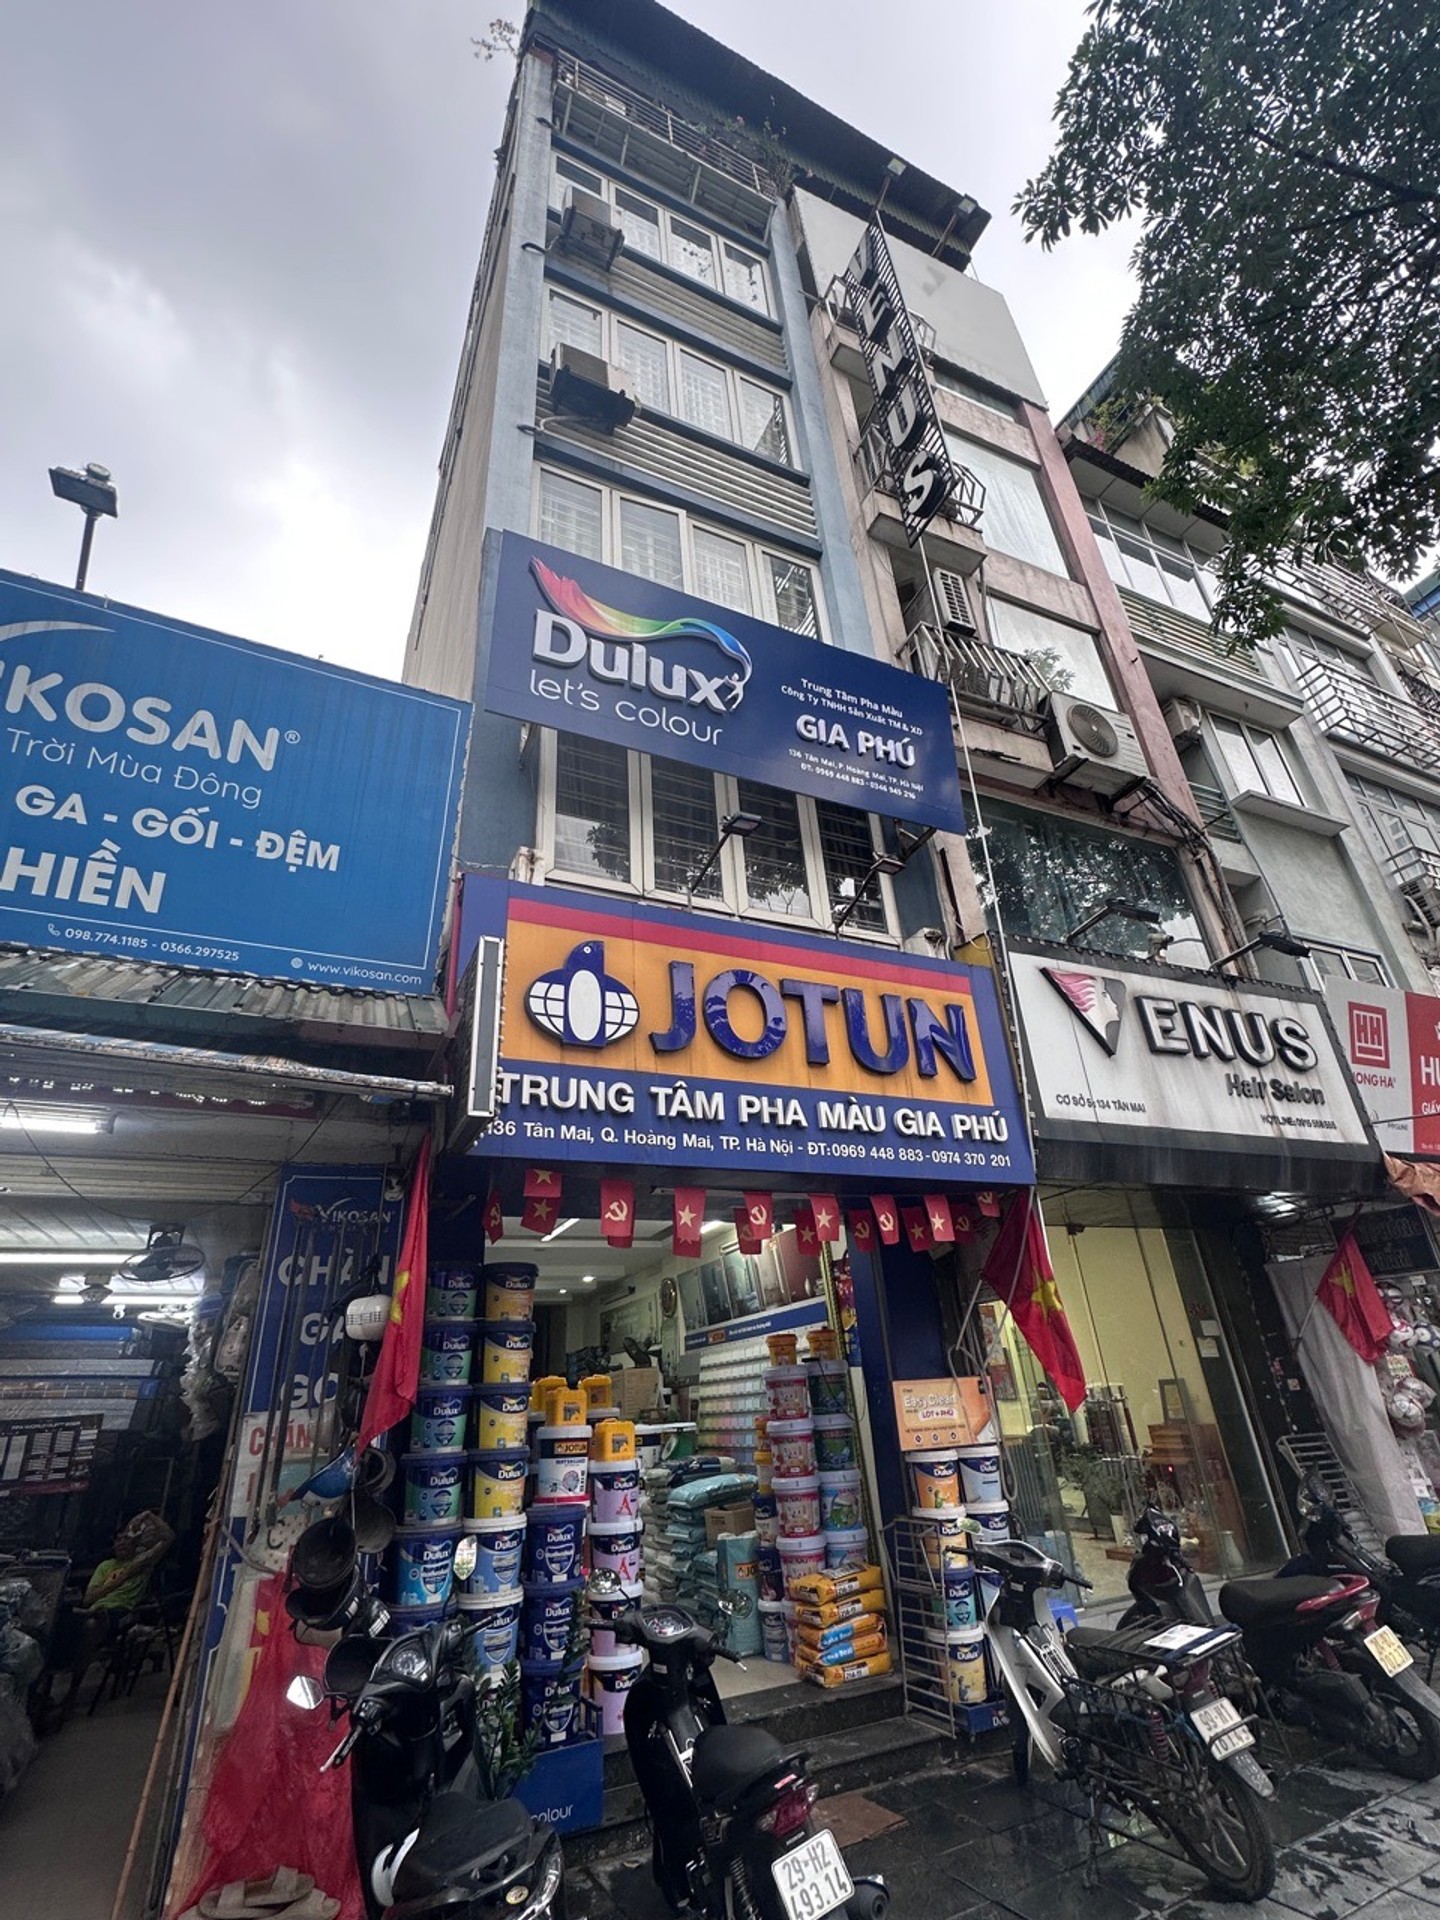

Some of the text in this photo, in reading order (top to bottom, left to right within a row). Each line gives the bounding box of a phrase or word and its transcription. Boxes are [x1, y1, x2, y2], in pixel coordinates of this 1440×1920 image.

[848, 230, 946, 519] VENUS
[532, 608, 731, 714] Dulux
[0, 660, 280, 771] KOSAN
[529, 669, 723, 746] let's colour
[781, 685, 805, 701] Công
[807, 693, 818, 705] Ty
[821, 698, 847, 712] TNHH
[888, 717, 901, 729] TM
[911, 724, 923, 736] XD
[801, 678, 903, 718] Trung Tâm Pha Màu
[796, 714, 916, 768] GIA PHÚ
[7, 727, 262, 809] Trời Mùa Đông
[15, 784, 87, 825] GA
[103, 813, 118, 823] -
[132, 806, 218, 849] GỐI
[256, 829, 340, 872] ĐỆM
[0, 838, 166, 913] HIỀN
[65, 928, 148, 948] 098.774.1185
[161, 940, 239, 962] 0366.297525
[307, 959, 422, 985] www.vikosan.com
[649, 961, 977, 1083] JOTUN
[500, 1072, 1009, 1142] TRUNG TÂM PHA MÀU GIA PHÚ
[1225, 1072, 1326, 1106] Hair Salon
[487, 1121, 516, 1136] 136
[523, 1122, 555, 1139] Tân
[560, 1124, 594, 1143] Mai,
[601, 1128, 618, 1143] Q.
[624, 1129, 676, 1150] Hoàng
[683, 1133, 714, 1152] Mai,
[720, 1135, 741, 1151] TP.
[746, 1137, 766, 1153] Hà
[770, 1140, 793, 1157] Nội
[870, 1146, 894, 1160] 448
[964, 1152, 985, 1166] 370
[991, 1154, 1011, 1167] 201
[433, 1406, 459, 1416] Dulux
[430, 1476, 456, 1486] Dulux
[423, 1550, 449, 1561] Dulux
[547, 1532, 572, 1543] Dulux
[611, 1542, 632, 1552] Dulux
[545, 1606, 571, 1617] Dulux
[782, 1840, 831, 1891] 29-H2
